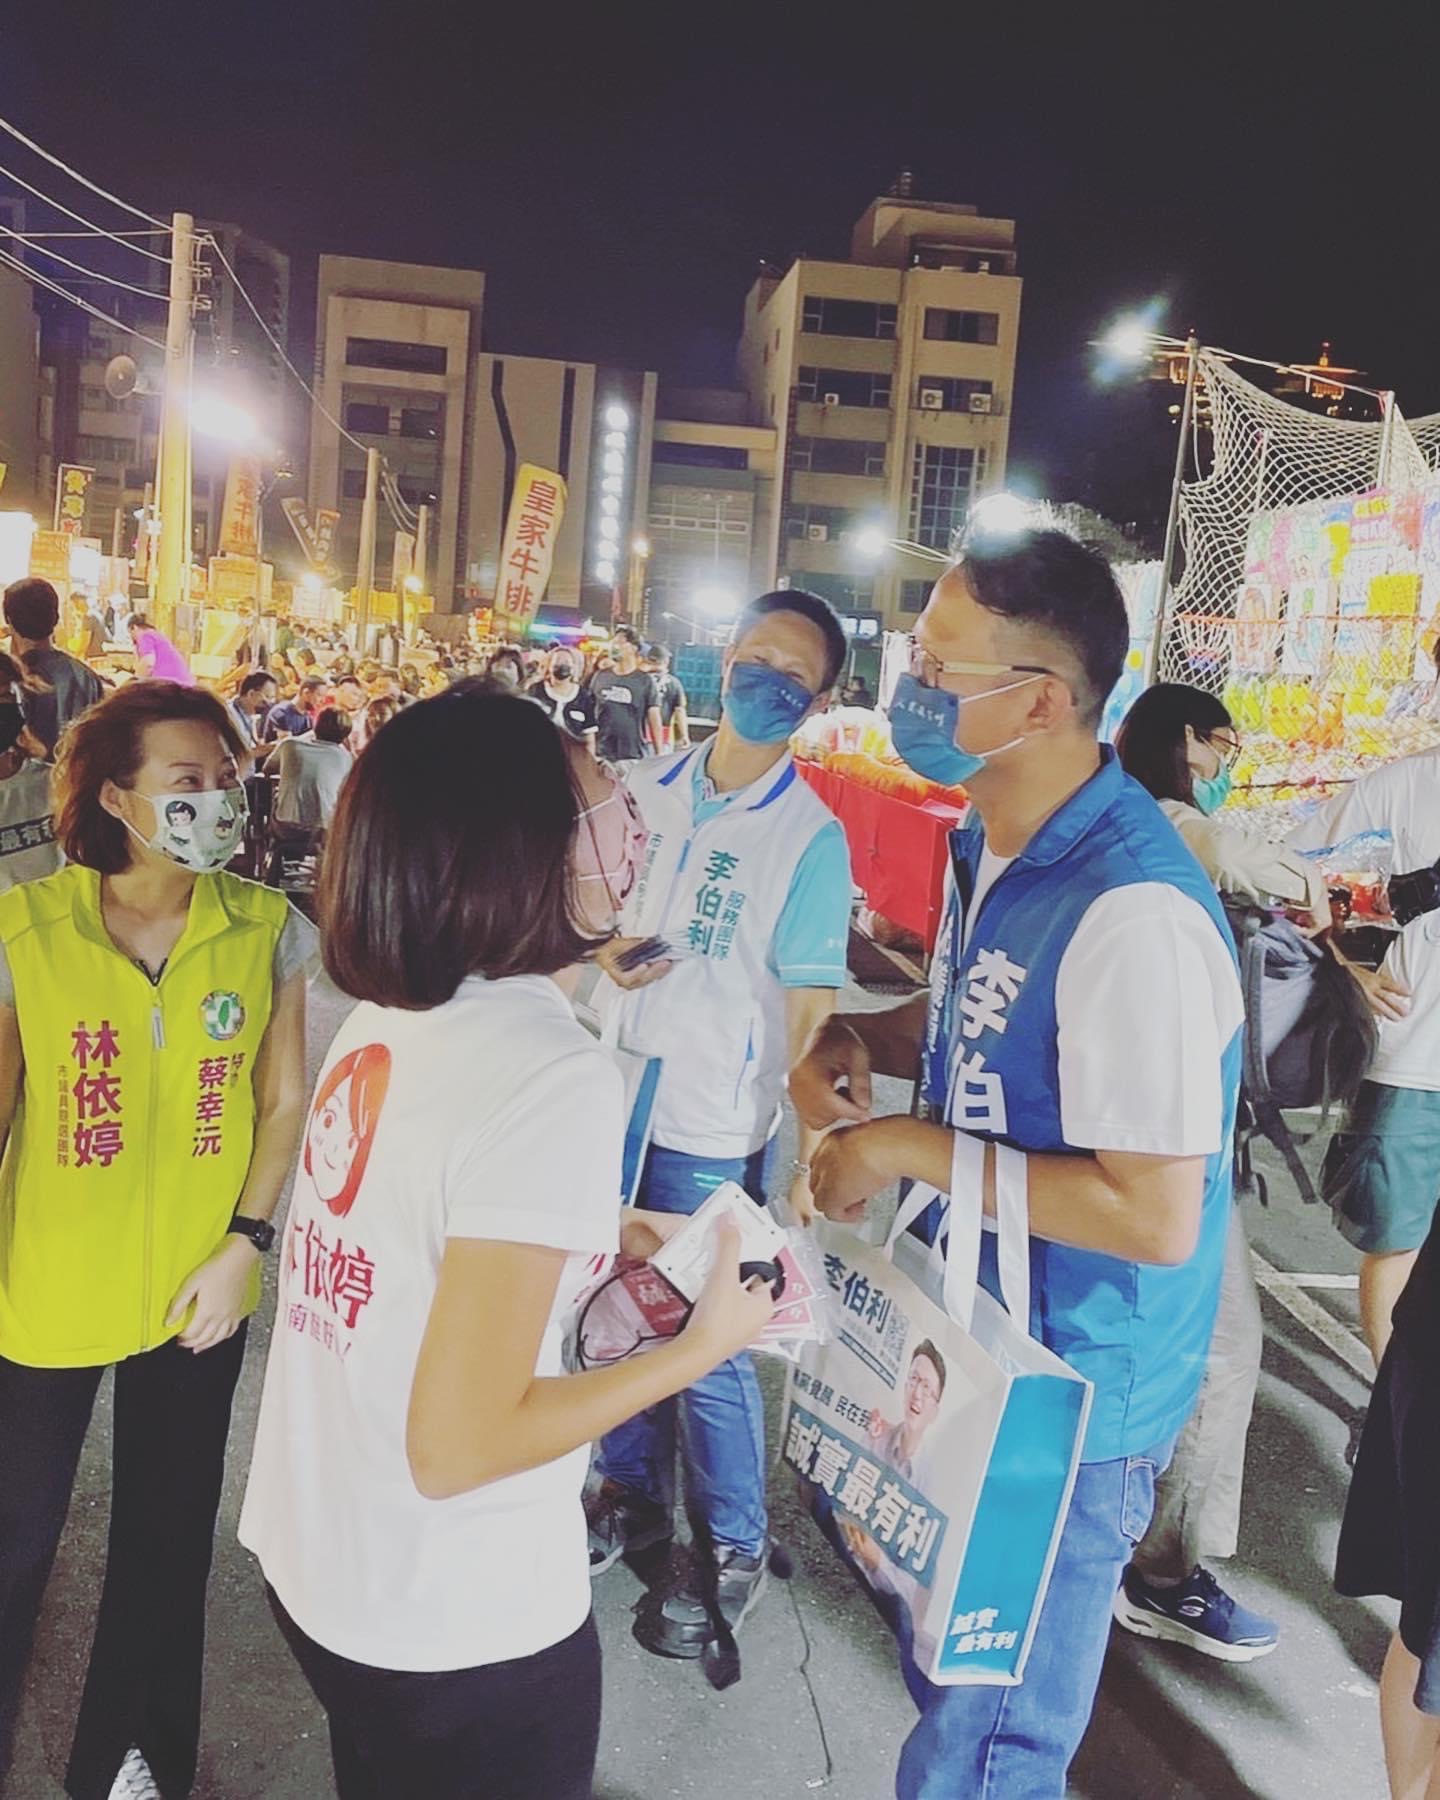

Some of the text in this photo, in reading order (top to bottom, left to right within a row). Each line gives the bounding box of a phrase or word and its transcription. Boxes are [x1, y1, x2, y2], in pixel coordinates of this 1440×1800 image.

[504, 480, 558, 617] 皇家牛排
[687, 850, 740, 955] 李伯利
[71, 1020, 124, 1169] 林依婷
[192, 1055, 229, 1158] 蔡幸沅
[823, 1252, 892, 1335] 李伯利
[784, 1412, 941, 1573] 誠實最有利
